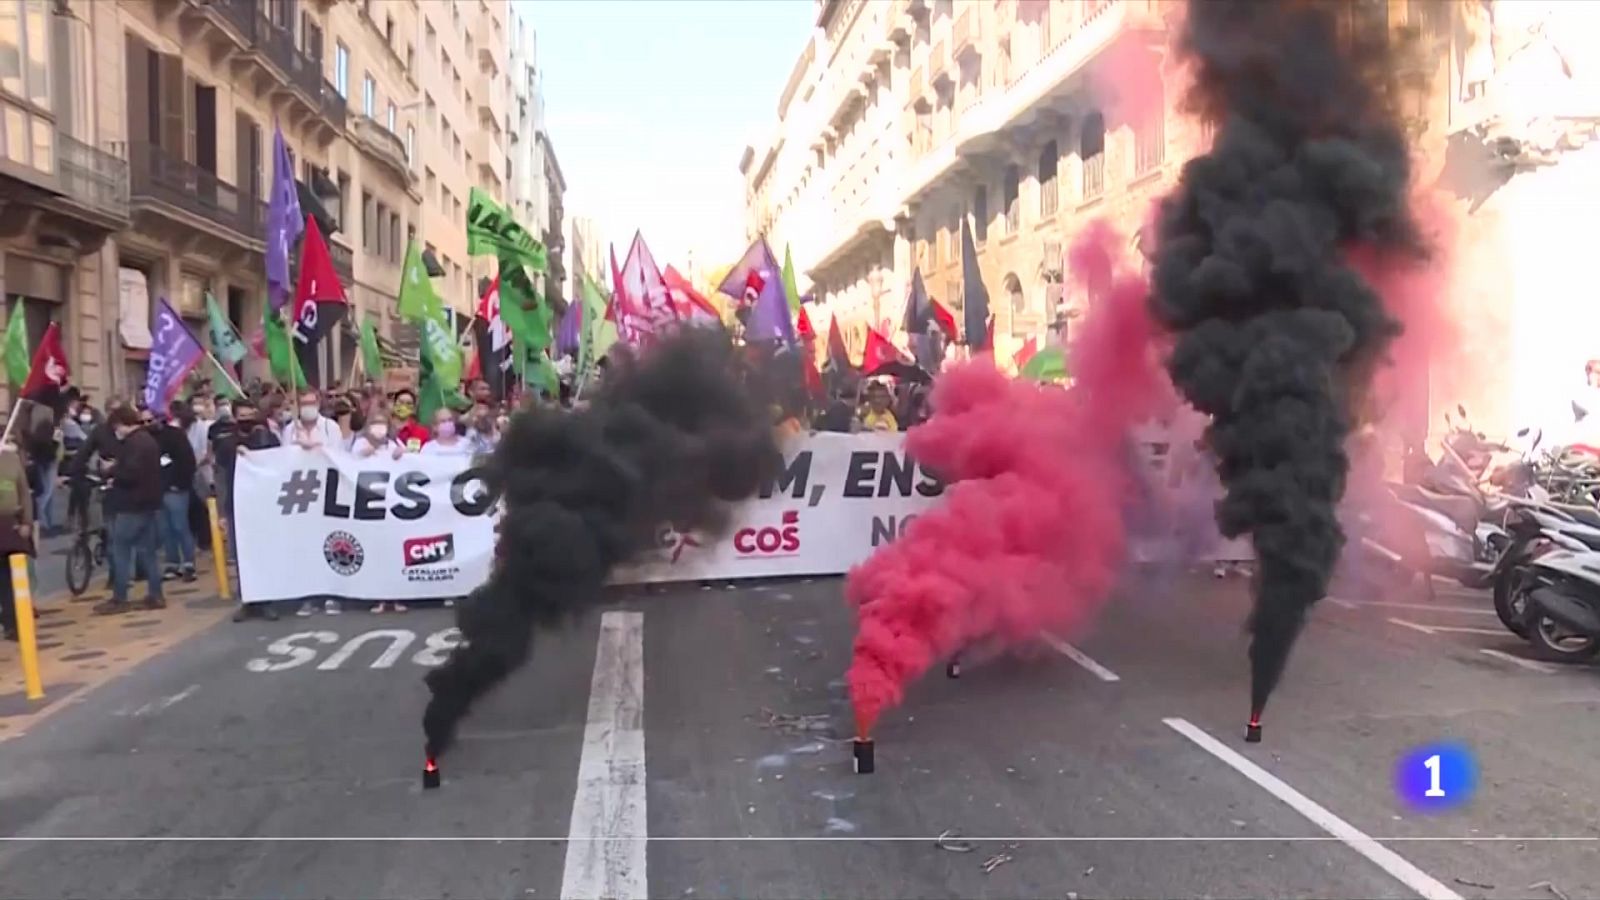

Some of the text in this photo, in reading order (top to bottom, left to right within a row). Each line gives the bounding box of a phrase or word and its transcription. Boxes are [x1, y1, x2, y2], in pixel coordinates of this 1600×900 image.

[277, 467, 499, 519] #LES Q
[758, 451, 826, 507] M,
[410, 541, 448, 559] CNT
